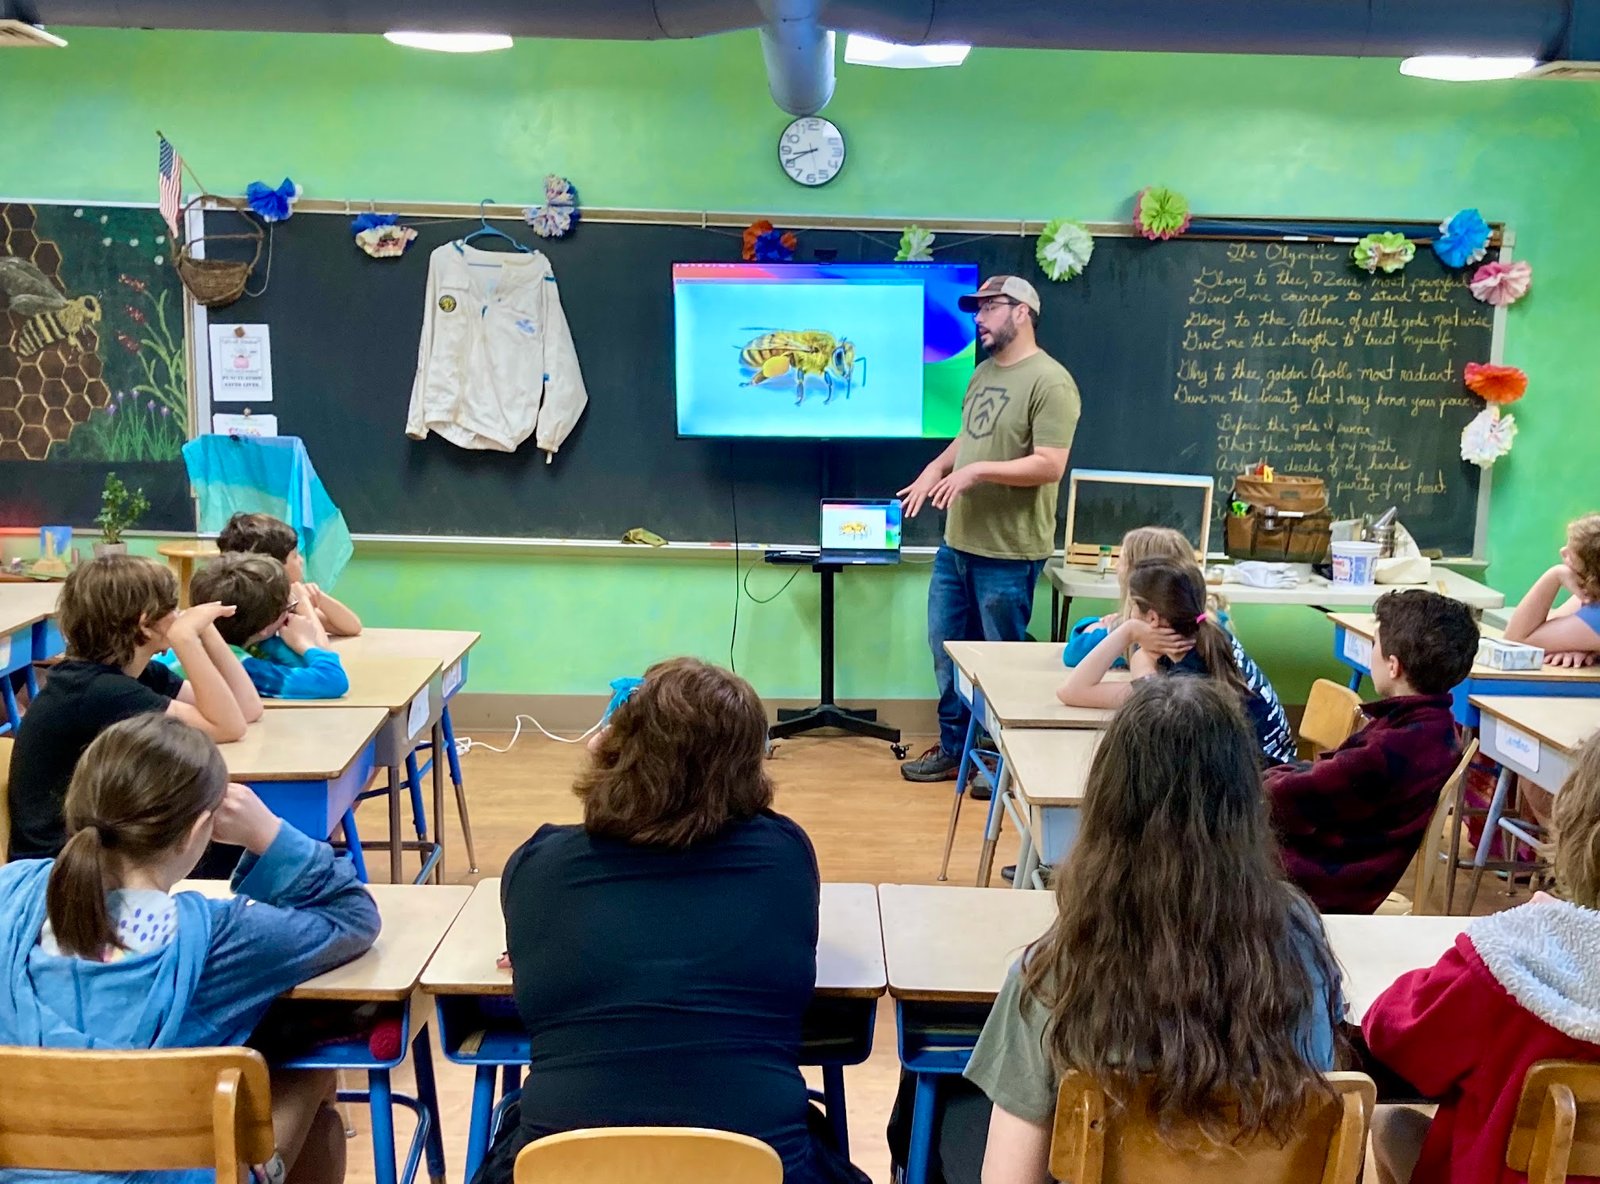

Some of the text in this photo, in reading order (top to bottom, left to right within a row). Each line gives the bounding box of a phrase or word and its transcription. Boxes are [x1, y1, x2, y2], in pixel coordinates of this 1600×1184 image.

[781, 145, 792, 155] 9
[785, 133, 800, 144] 10
[785, 159, 796, 168] 8
[832, 147, 843, 158] 3
[795, 168, 803, 178] 7
[818, 170, 829, 180] 5
[828, 160, 838, 170] 4
[806, 173, 817, 184] 6
[1227, 243, 1258, 260] The
[1266, 242, 1339, 269] Olympic
[1194, 266, 1247, 298] Glory
[1254, 268, 1267, 286] to
[1371, 273, 1405, 288] most
[1189, 287, 1233, 304] Give
[1246, 294, 1272, 302] me
[1281, 293, 1340, 309] courage
[1344, 290, 1362, 302] to
[1370, 290, 1412, 302] stand
[1184, 311, 1226, 339] Glory
[1234, 309, 1250, 328] to
[1350, 307, 1363, 333] of
[1361, 309, 1381, 328] all
[1382, 306, 1400, 328] the
[1401, 311, 1430, 336] gods
[1433, 307, 1459, 331] most
[1182, 330, 1223, 351] Give
[1226, 339, 1245, 349] me
[1250, 330, 1276, 348] the
[1281, 330, 1338, 354] strength
[1342, 331, 1354, 347] to
[1362, 330, 1396, 346] trust
[1176, 357, 1208, 389] Glory
[1214, 361, 1225, 381] to
[1266, 362, 1308, 391] golden
[1310, 357, 1352, 387] Apollo
[1358, 355, 1396, 381] most
[1174, 383, 1208, 405] Give
[1209, 394, 1227, 404] me
[1228, 383, 1251, 403] the
[1257, 387, 1302, 414] beauty
[1305, 385, 1332, 405] that
[1346, 394, 1371, 415] may
[1410, 396, 1436, 417] your
[1217, 413, 1260, 436] Before
[1266, 415, 1289, 432] the
[1292, 419, 1320, 440] gods
[1217, 435, 1254, 453] That
[1259, 435, 1283, 453] the
[1287, 439, 1322, 453] words
[1326, 436, 1336, 460] of
[1339, 442, 1357, 463] my
[1216, 455, 1247, 473] And
[1327, 456, 1339, 479] of
[1345, 464, 1362, 481] my
[1367, 452, 1412, 471] hands
[1380, 474, 1393, 500] of
[1394, 481, 1411, 503] my
